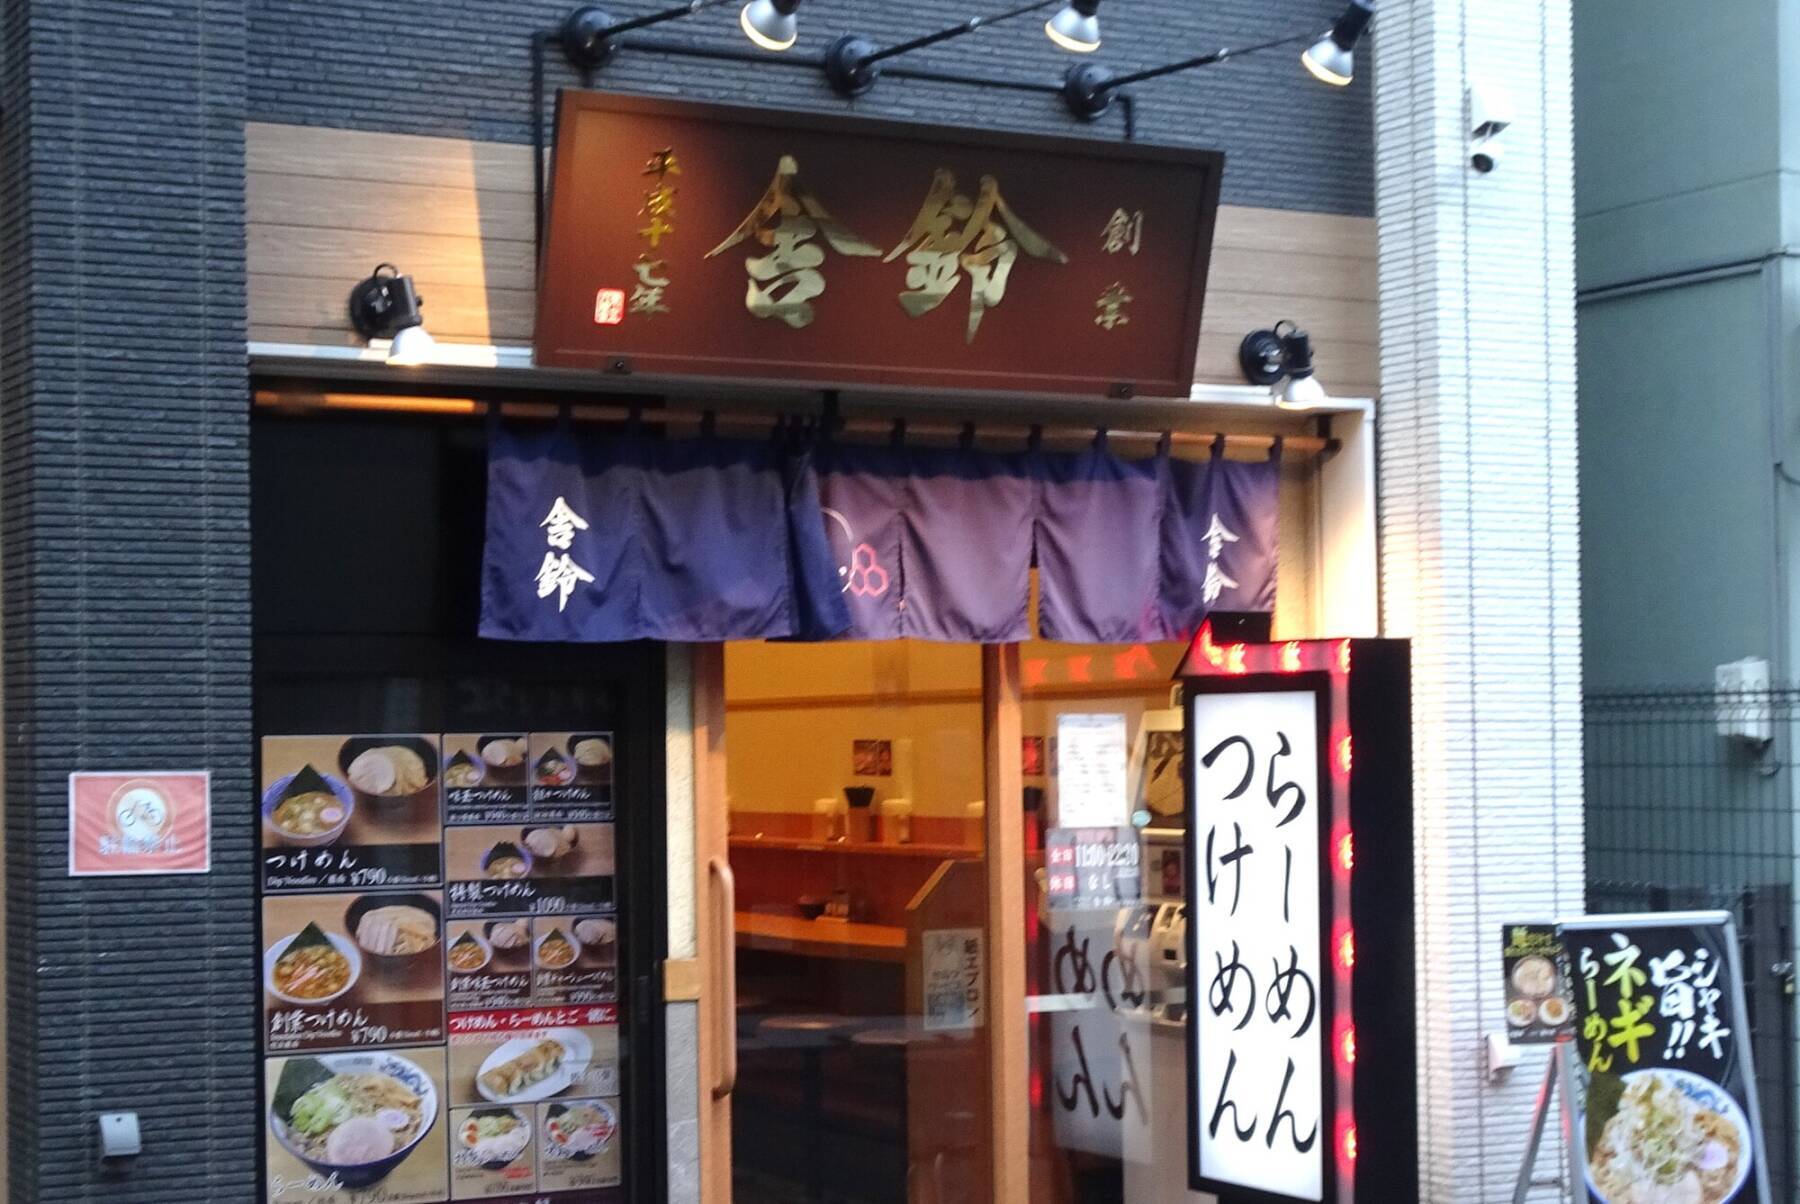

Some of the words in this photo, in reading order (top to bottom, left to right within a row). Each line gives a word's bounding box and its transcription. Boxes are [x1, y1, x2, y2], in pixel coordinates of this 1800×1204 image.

[534, 496, 596, 612] 舎鈴
[266, 849, 358, 871] つけめん
[1201, 734, 1258, 1142] つけめん
[1265, 731, 1318, 1154] らーめん
[1603, 932, 1656, 1063] ネギ
[1579, 947, 1614, 1073] らーめん
